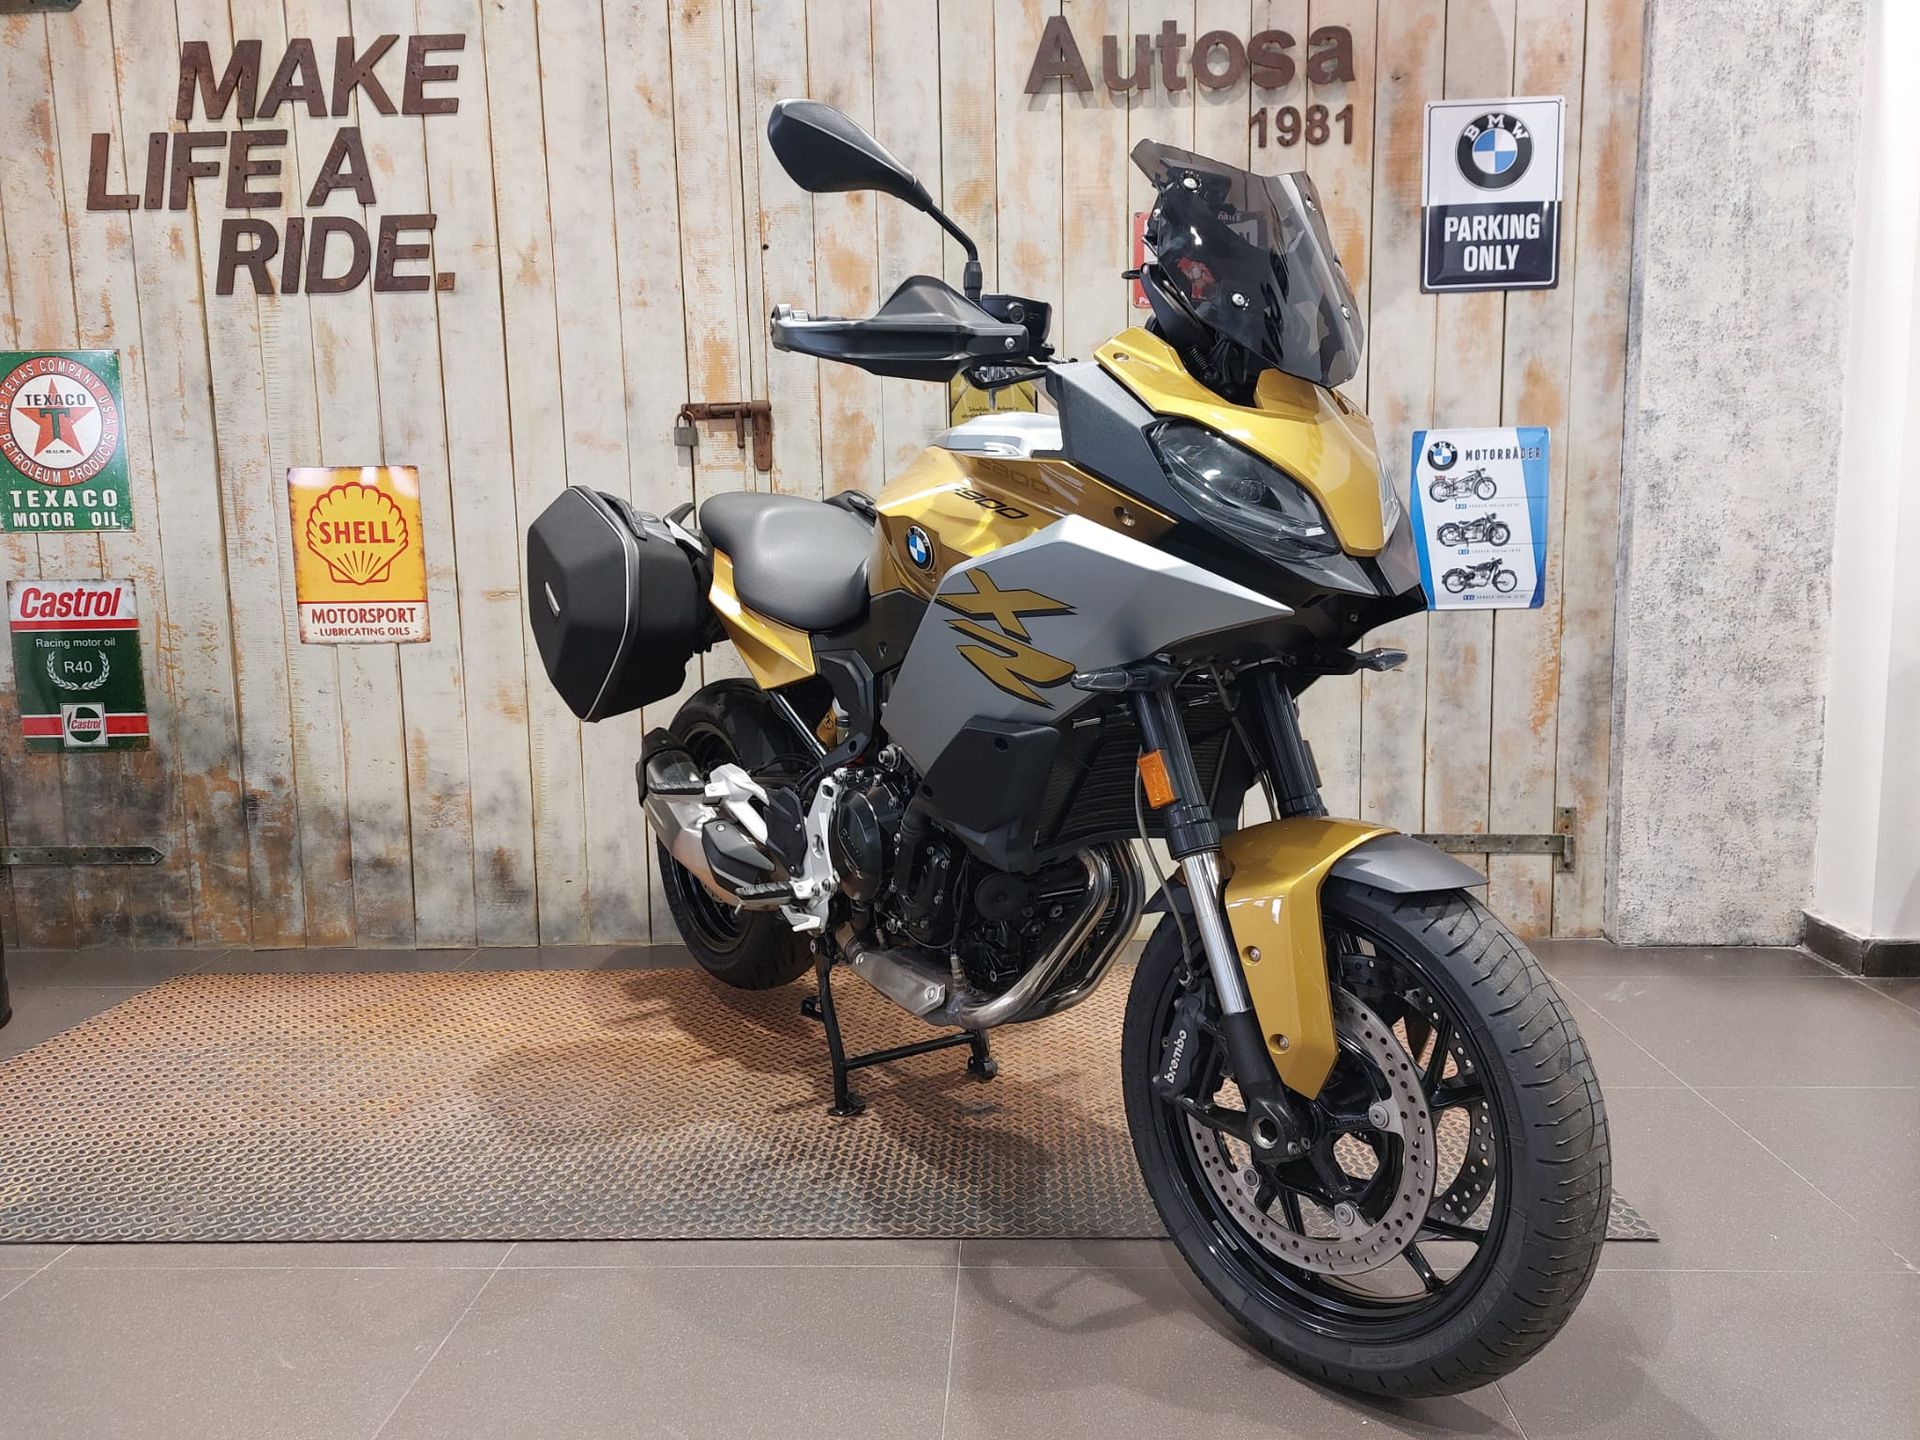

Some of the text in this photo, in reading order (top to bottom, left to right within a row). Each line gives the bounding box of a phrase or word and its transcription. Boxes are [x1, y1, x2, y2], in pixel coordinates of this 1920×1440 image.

[1024, 15, 1355, 94] Autosa
[176, 34, 466, 120] MAKE
[1248, 104, 1354, 149] 1981
[1464, 114, 1529, 141] BMW
[87, 126, 376, 210] LIFE A
[1444, 213, 1540, 243] PARKING
[215, 214, 455, 296] RIDE.
[1463, 243, 1519, 273] ONLY
[39, 359, 101, 392] COMPANY
[24, 393, 87, 406] TEXACO
[0, 433, 116, 483] PETROLEUM PRODUCTS
[9, 489, 118, 508] TEXACO
[12, 511, 121, 527] MOTOR OIL
[319, 521, 396, 544] SHELL
[20, 587, 122, 619] Castrol
[311, 607, 416, 624] MOTORSPORT
[36, 637, 116, 650] Racing motor oil
[319, 626, 410, 637] LUBRICATING OILS
[64, 660, 93, 674] R40
[71, 718, 102, 731] Castrol
[1164, 1029, 1187, 1085] brembo
